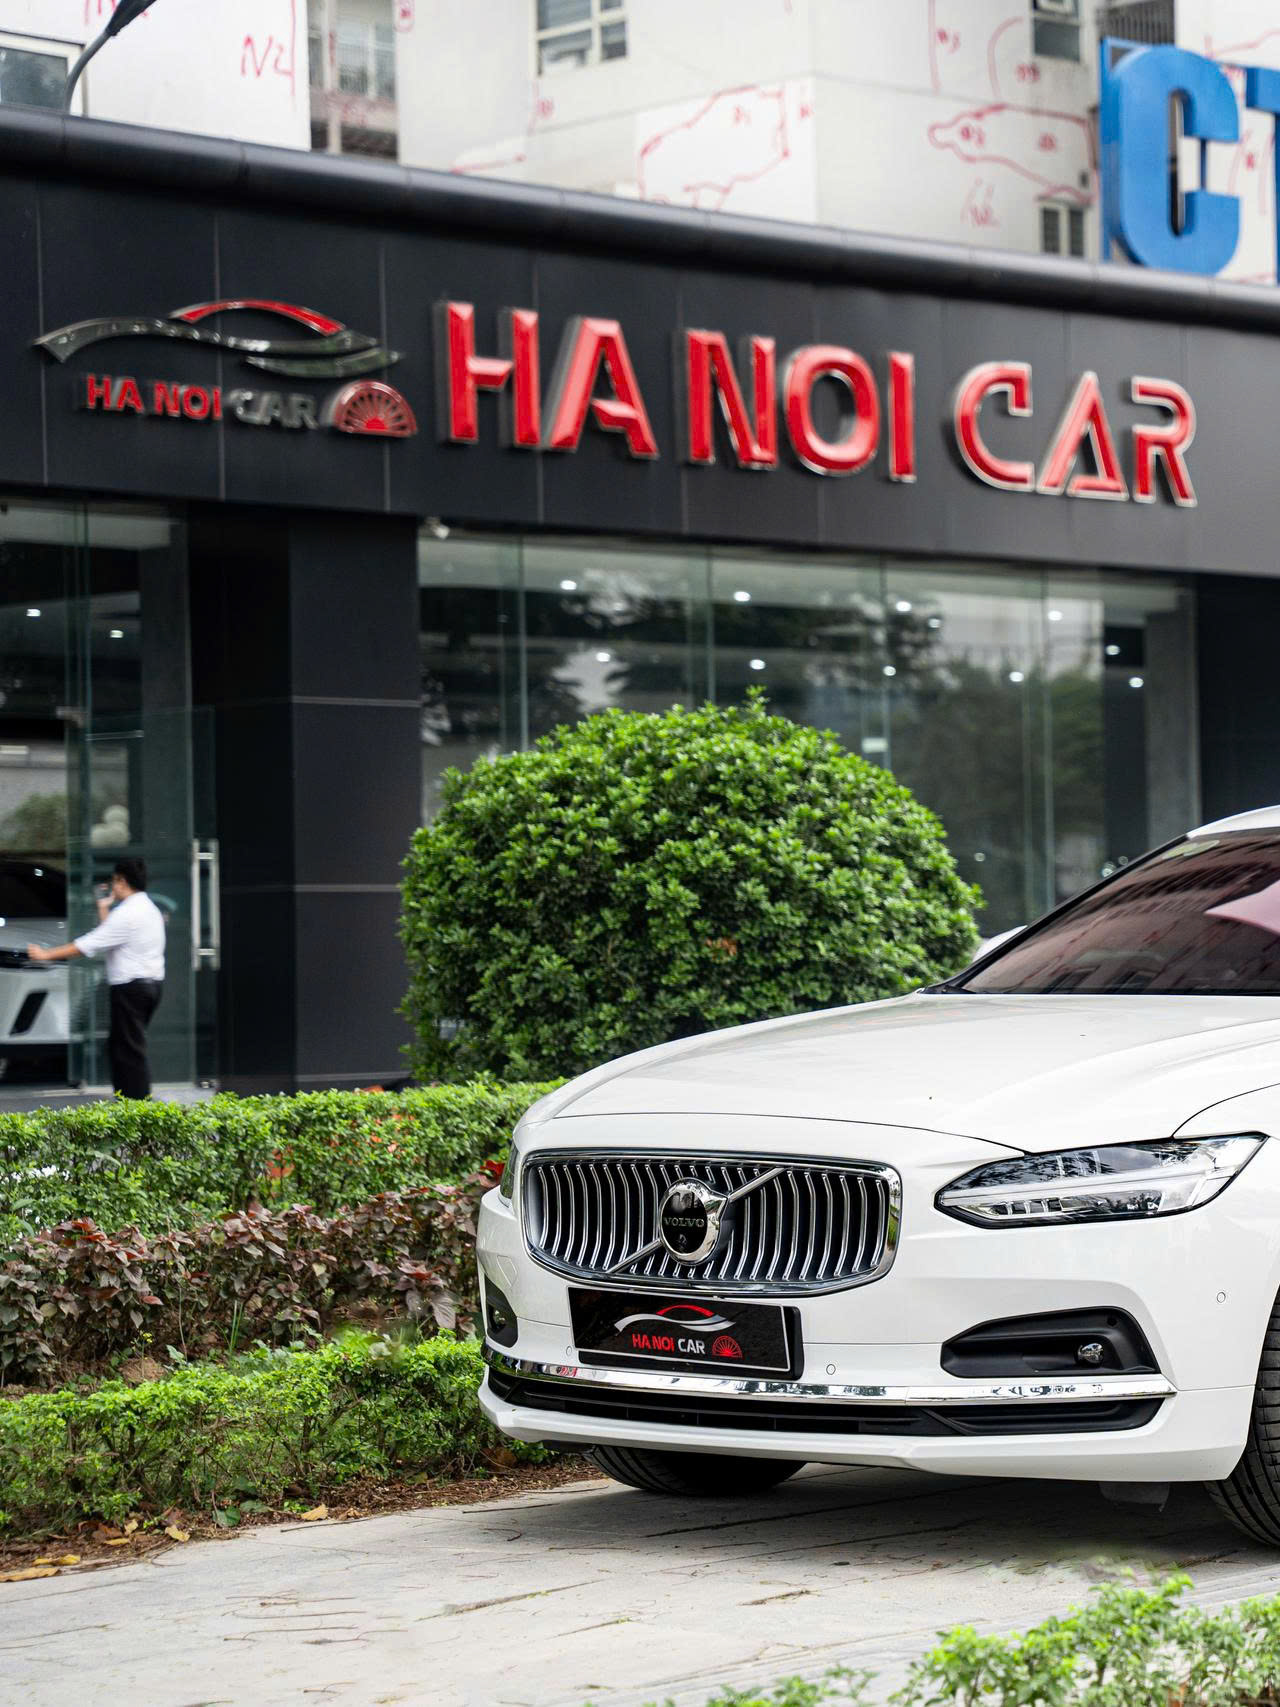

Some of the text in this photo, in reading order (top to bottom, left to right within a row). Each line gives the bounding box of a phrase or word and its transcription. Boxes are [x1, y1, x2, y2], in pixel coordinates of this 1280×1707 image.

[86, 373, 319, 430] HA NOI CAR
[442, 301, 1197, 507] HA NOI CAR
[663, 1217, 705, 1228] VOLVO
[632, 1333, 705, 1355] HA NOI CAR
